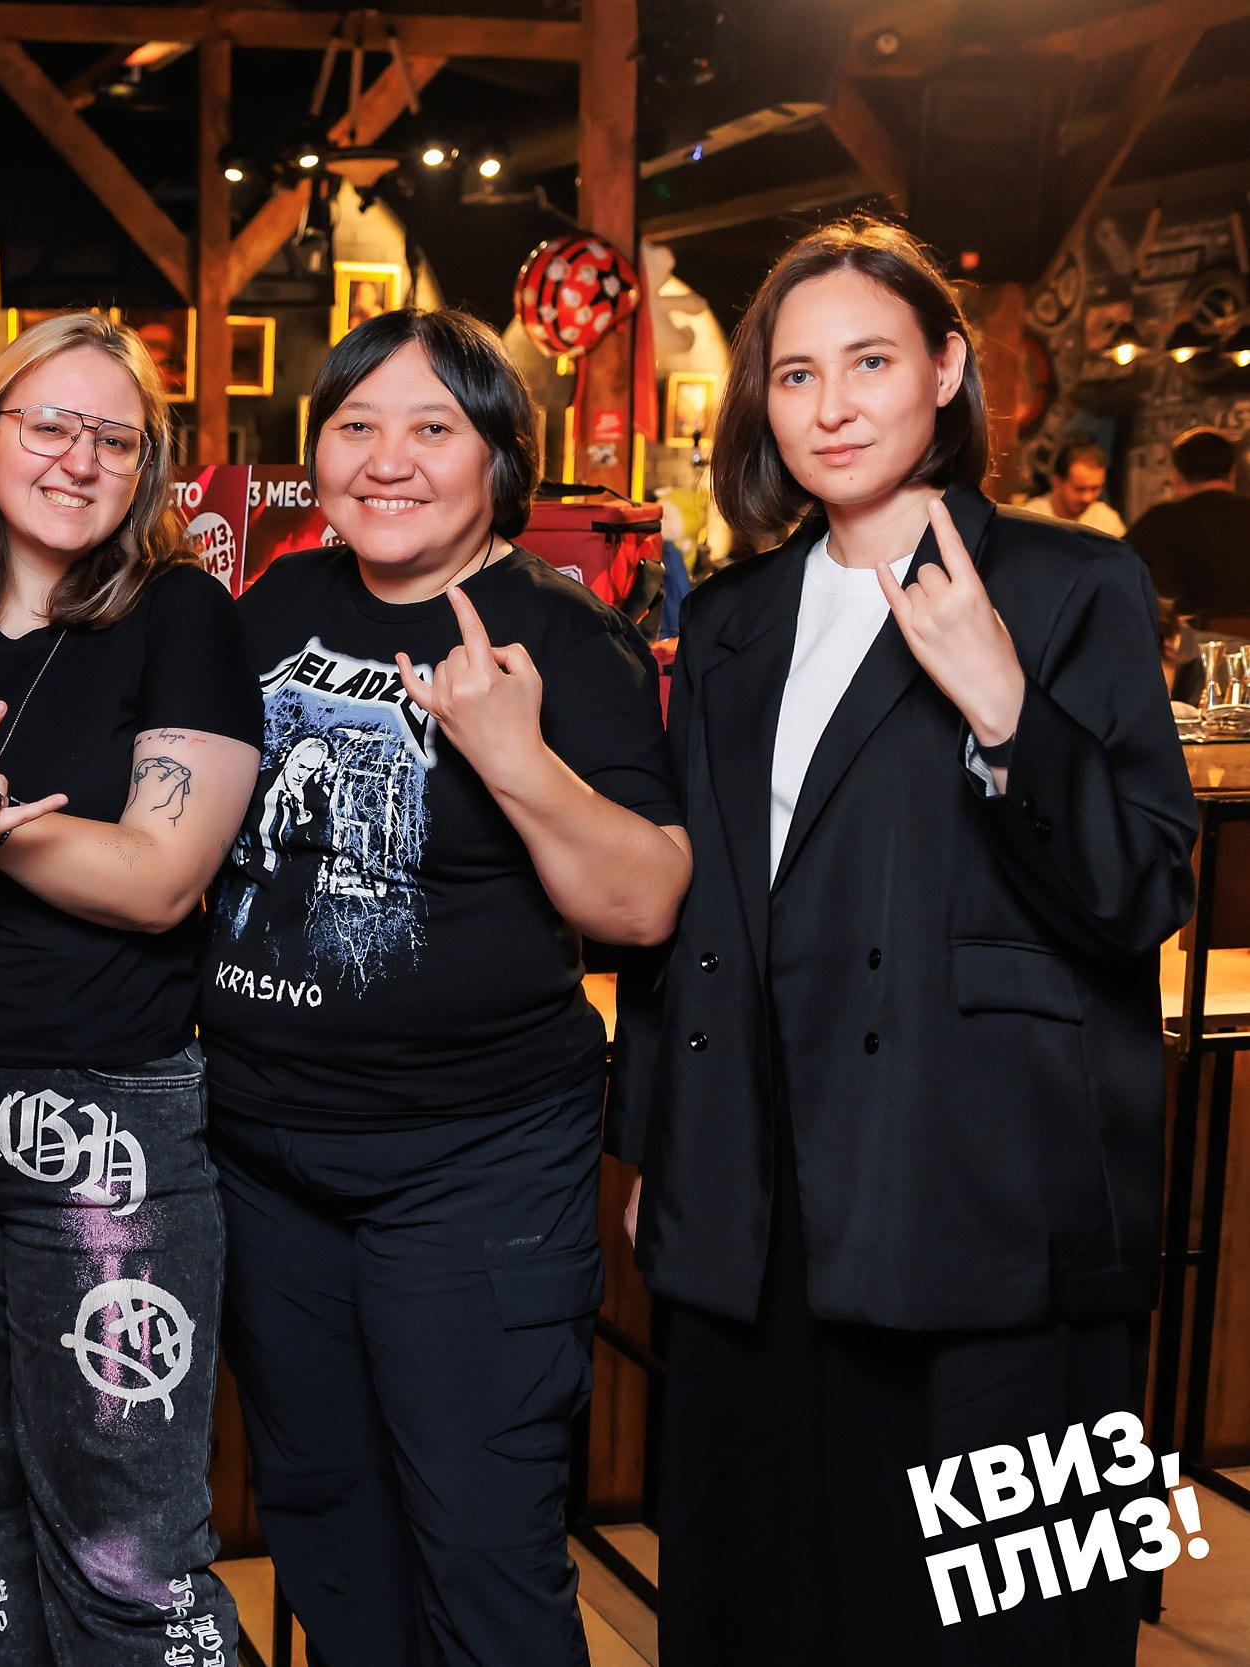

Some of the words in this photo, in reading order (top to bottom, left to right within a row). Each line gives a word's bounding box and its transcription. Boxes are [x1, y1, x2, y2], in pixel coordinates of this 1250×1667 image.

[250, 482, 261, 507] 3
[266, 481, 320, 507] МЕС
[198, 524, 234, 550] ИЗ,
[204, 548, 235, 574] ИЗ!
[216, 961, 323, 1007] KRASIVO
